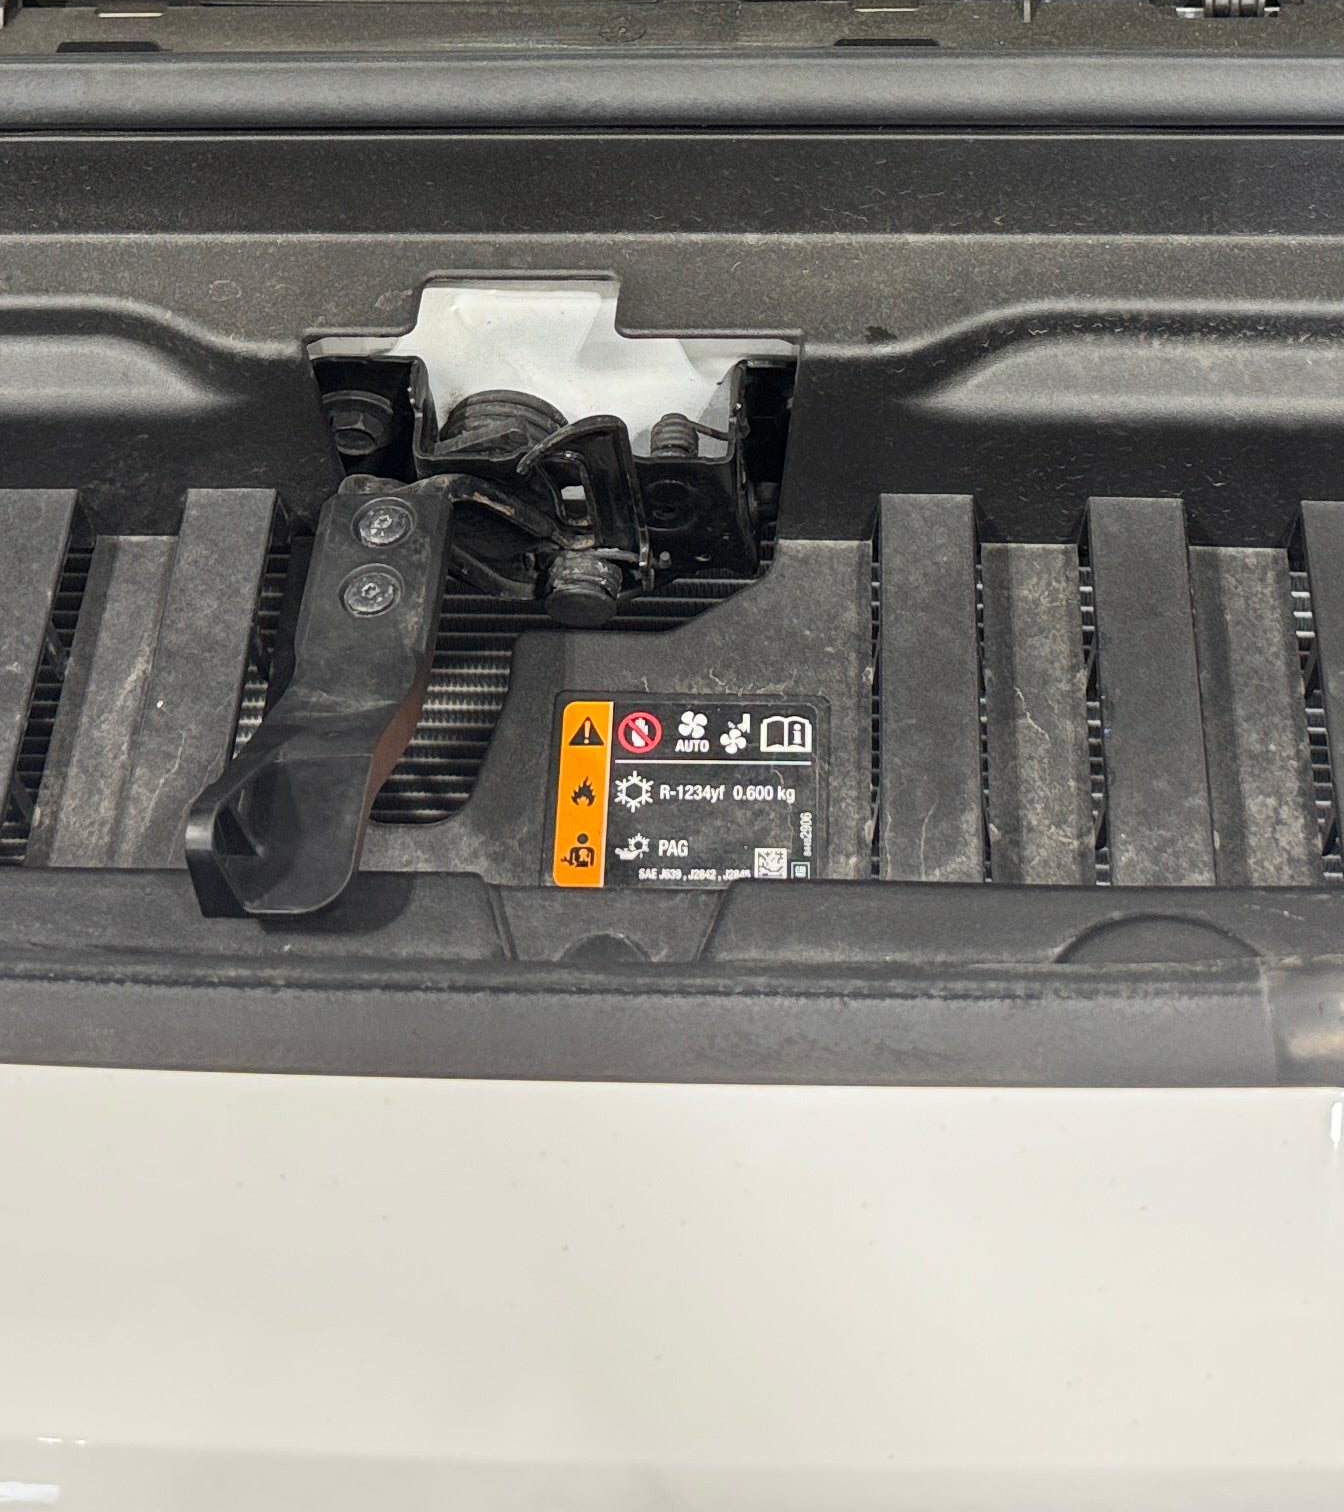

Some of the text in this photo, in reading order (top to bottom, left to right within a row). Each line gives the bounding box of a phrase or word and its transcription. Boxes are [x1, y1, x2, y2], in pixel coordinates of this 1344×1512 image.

[675, 739, 710, 753] AUTO
[660, 784, 796, 804] R-1234yf 0.600 kg
[658, 840, 689, 857] PAG
[638, 868, 657, 881] SAE
